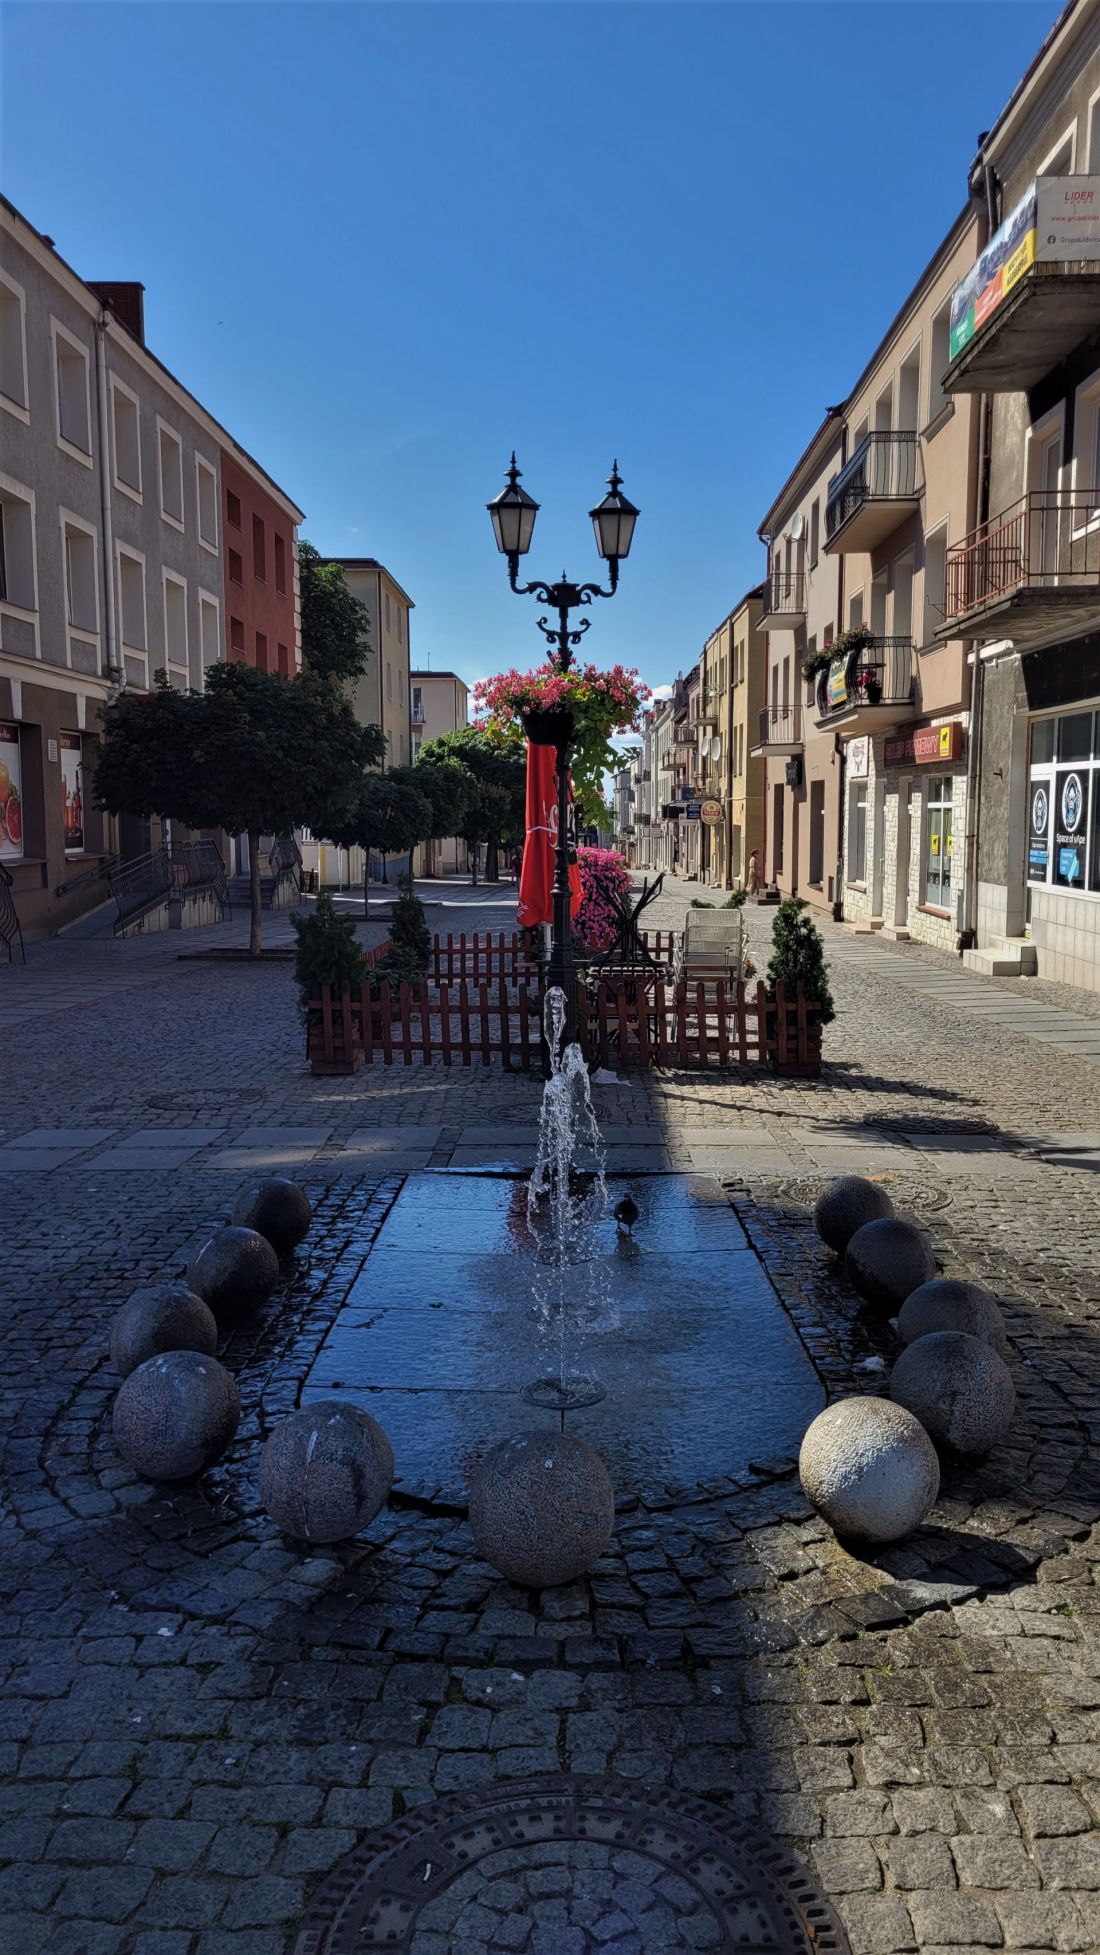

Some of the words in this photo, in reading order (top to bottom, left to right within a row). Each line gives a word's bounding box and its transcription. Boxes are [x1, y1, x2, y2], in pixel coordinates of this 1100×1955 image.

[1064, 191, 1094, 201] LIDER
[1056, 833, 1069, 845] Space
[1069, 833, 1074, 843] of
